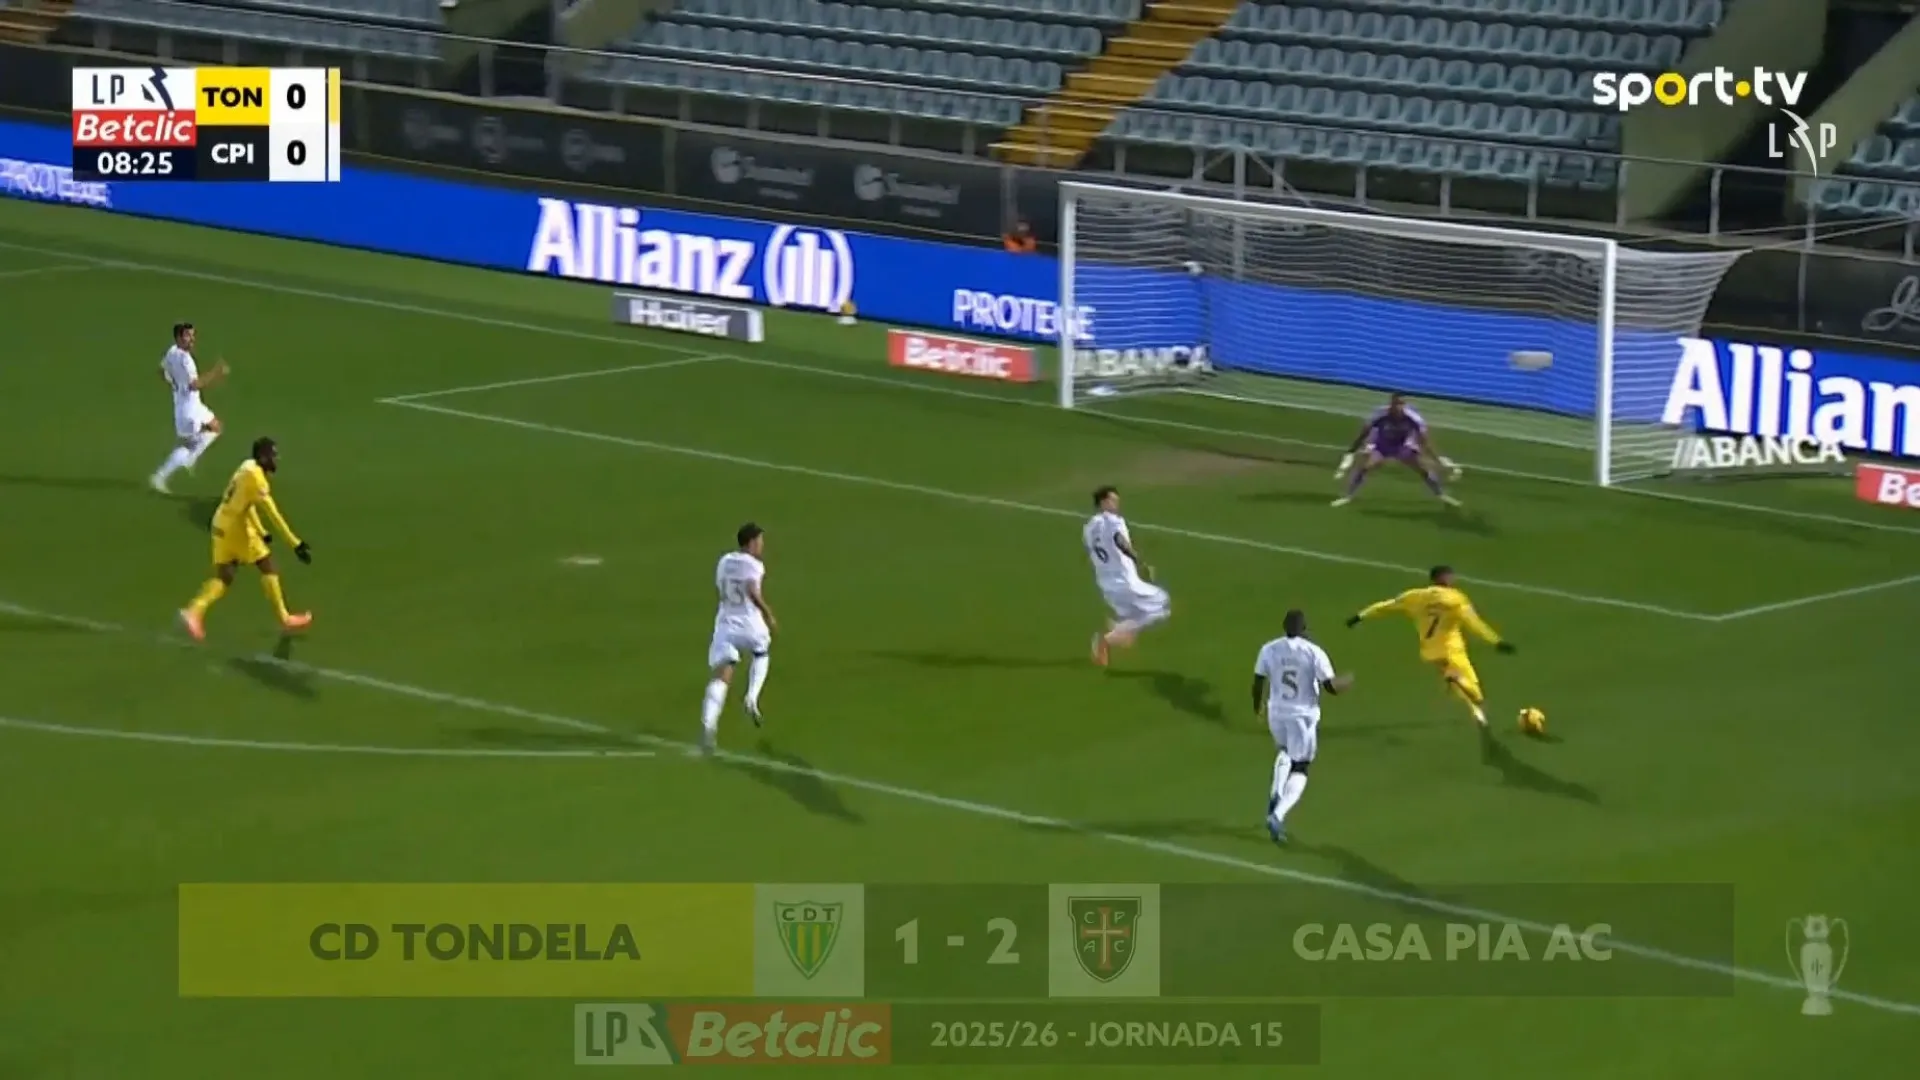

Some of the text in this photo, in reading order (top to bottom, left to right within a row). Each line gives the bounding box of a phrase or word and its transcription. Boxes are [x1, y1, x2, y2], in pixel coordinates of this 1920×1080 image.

[527, 197, 754, 298] Allianz
[953, 288, 1096, 341] PROTEE
[1281, 670, 1299, 700] 5
